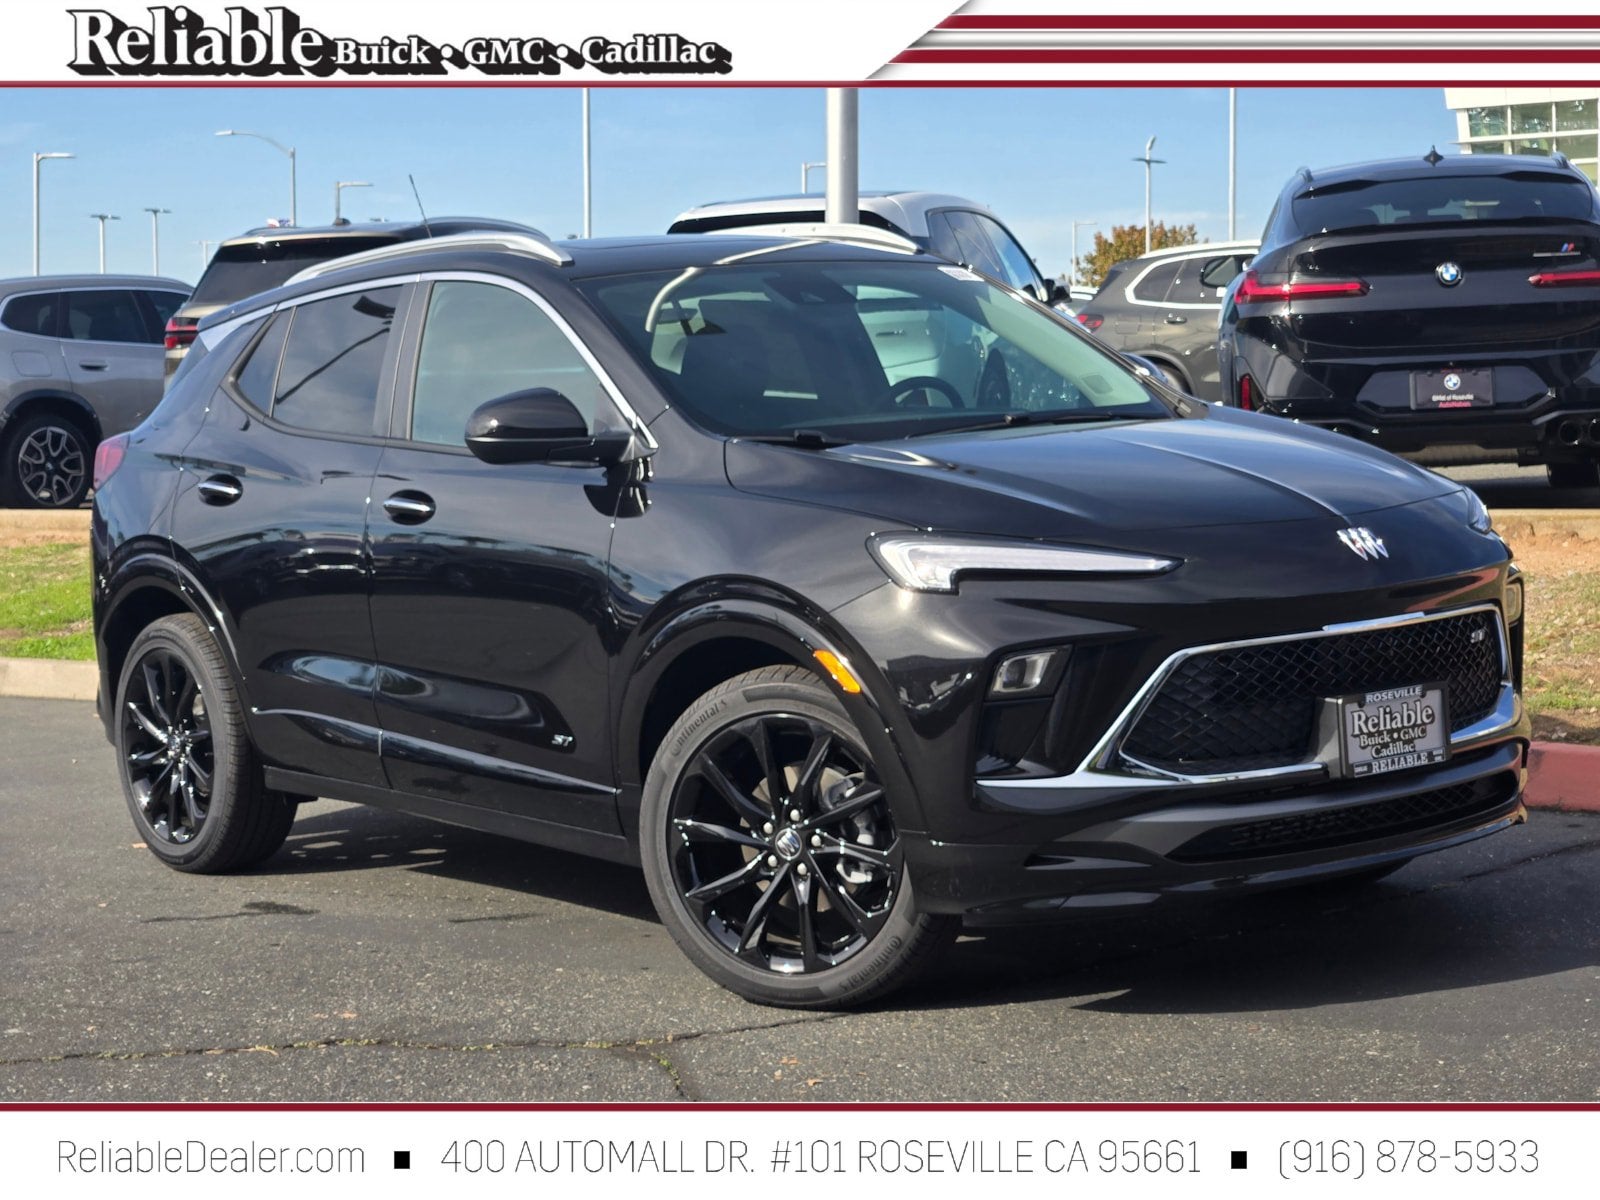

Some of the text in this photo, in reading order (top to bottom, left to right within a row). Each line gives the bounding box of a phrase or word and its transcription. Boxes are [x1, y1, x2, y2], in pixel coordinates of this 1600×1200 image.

[1366, 686, 1422, 703] ROSEVILLE
[1351, 699, 1435, 737] Reliable
[1360, 725, 1427, 748] Buick GMC
[1371, 741, 1415, 759] Cadillac
[1371, 752, 1428, 773] RELIABLE
